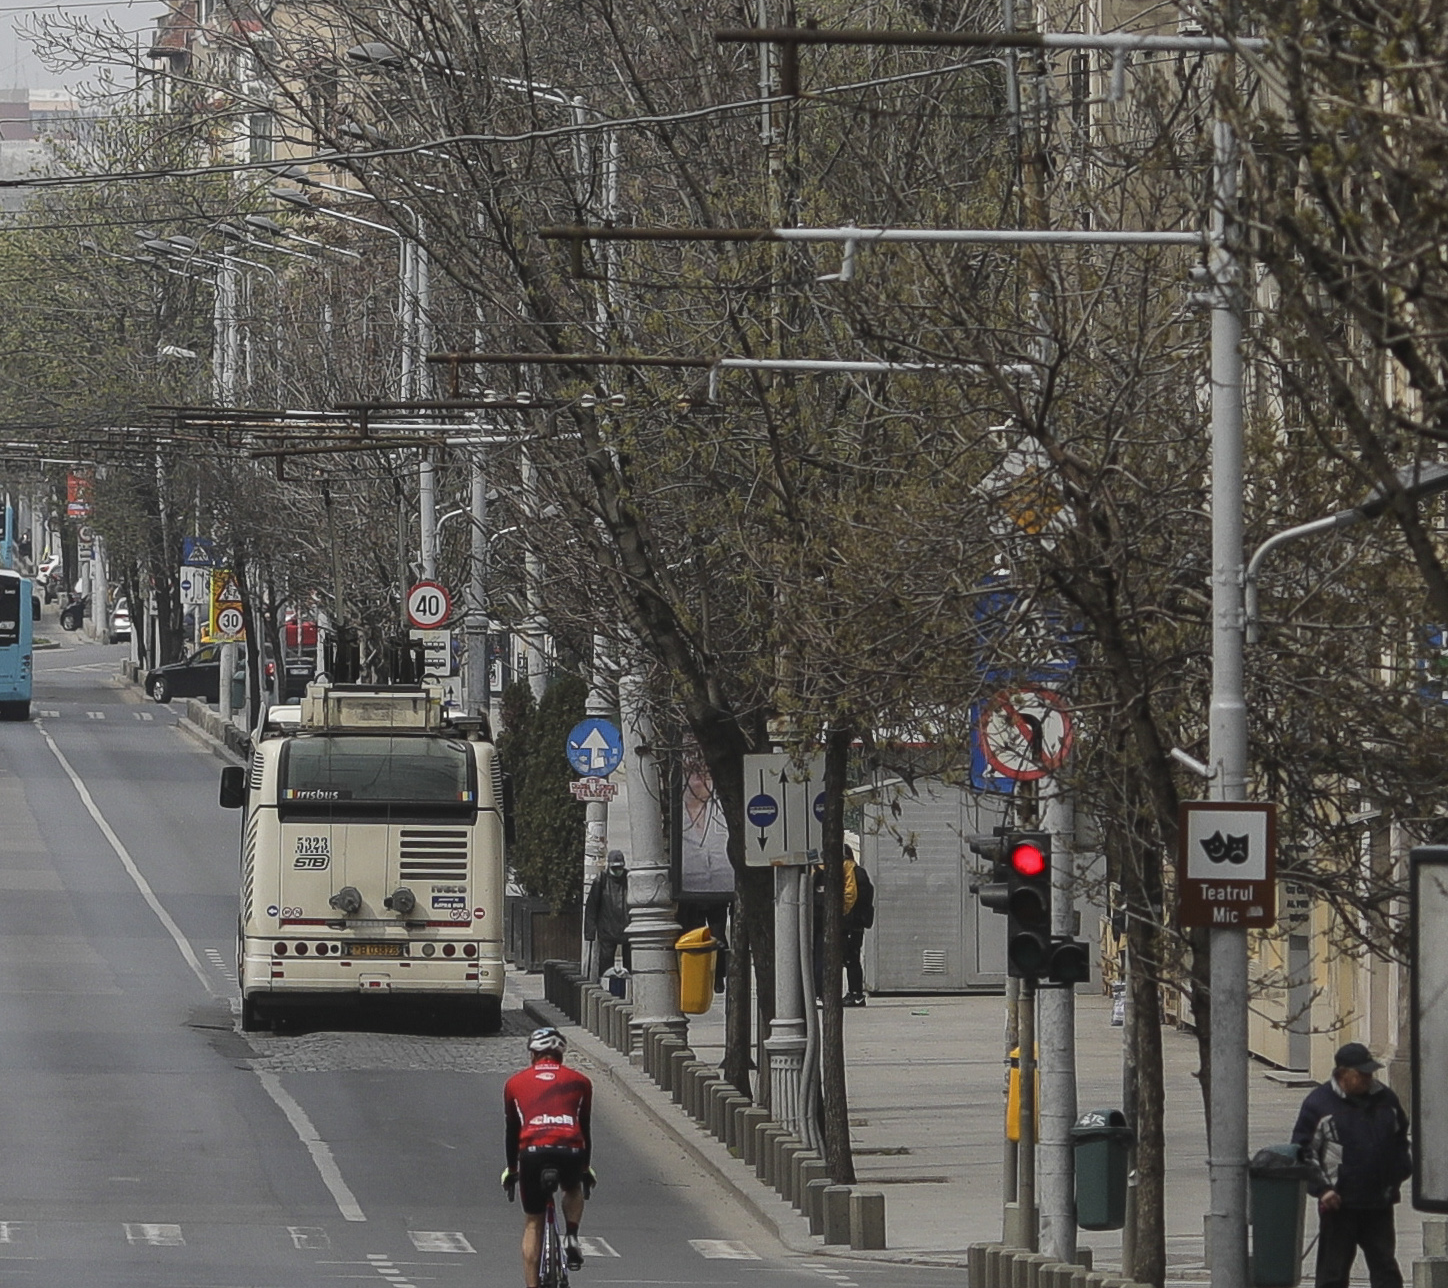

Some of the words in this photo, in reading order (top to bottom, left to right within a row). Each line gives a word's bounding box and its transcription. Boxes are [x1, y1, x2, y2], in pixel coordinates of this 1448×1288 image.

[415, 594, 440, 617] 40
[222, 613, 239, 629] 30
[297, 788, 339, 800] irisbus
[296, 836, 329, 854] 5323
[294, 857, 326, 868] STB
[1200, 884, 1254, 901] Teatrul
[1213, 906, 1239, 923] Mic
